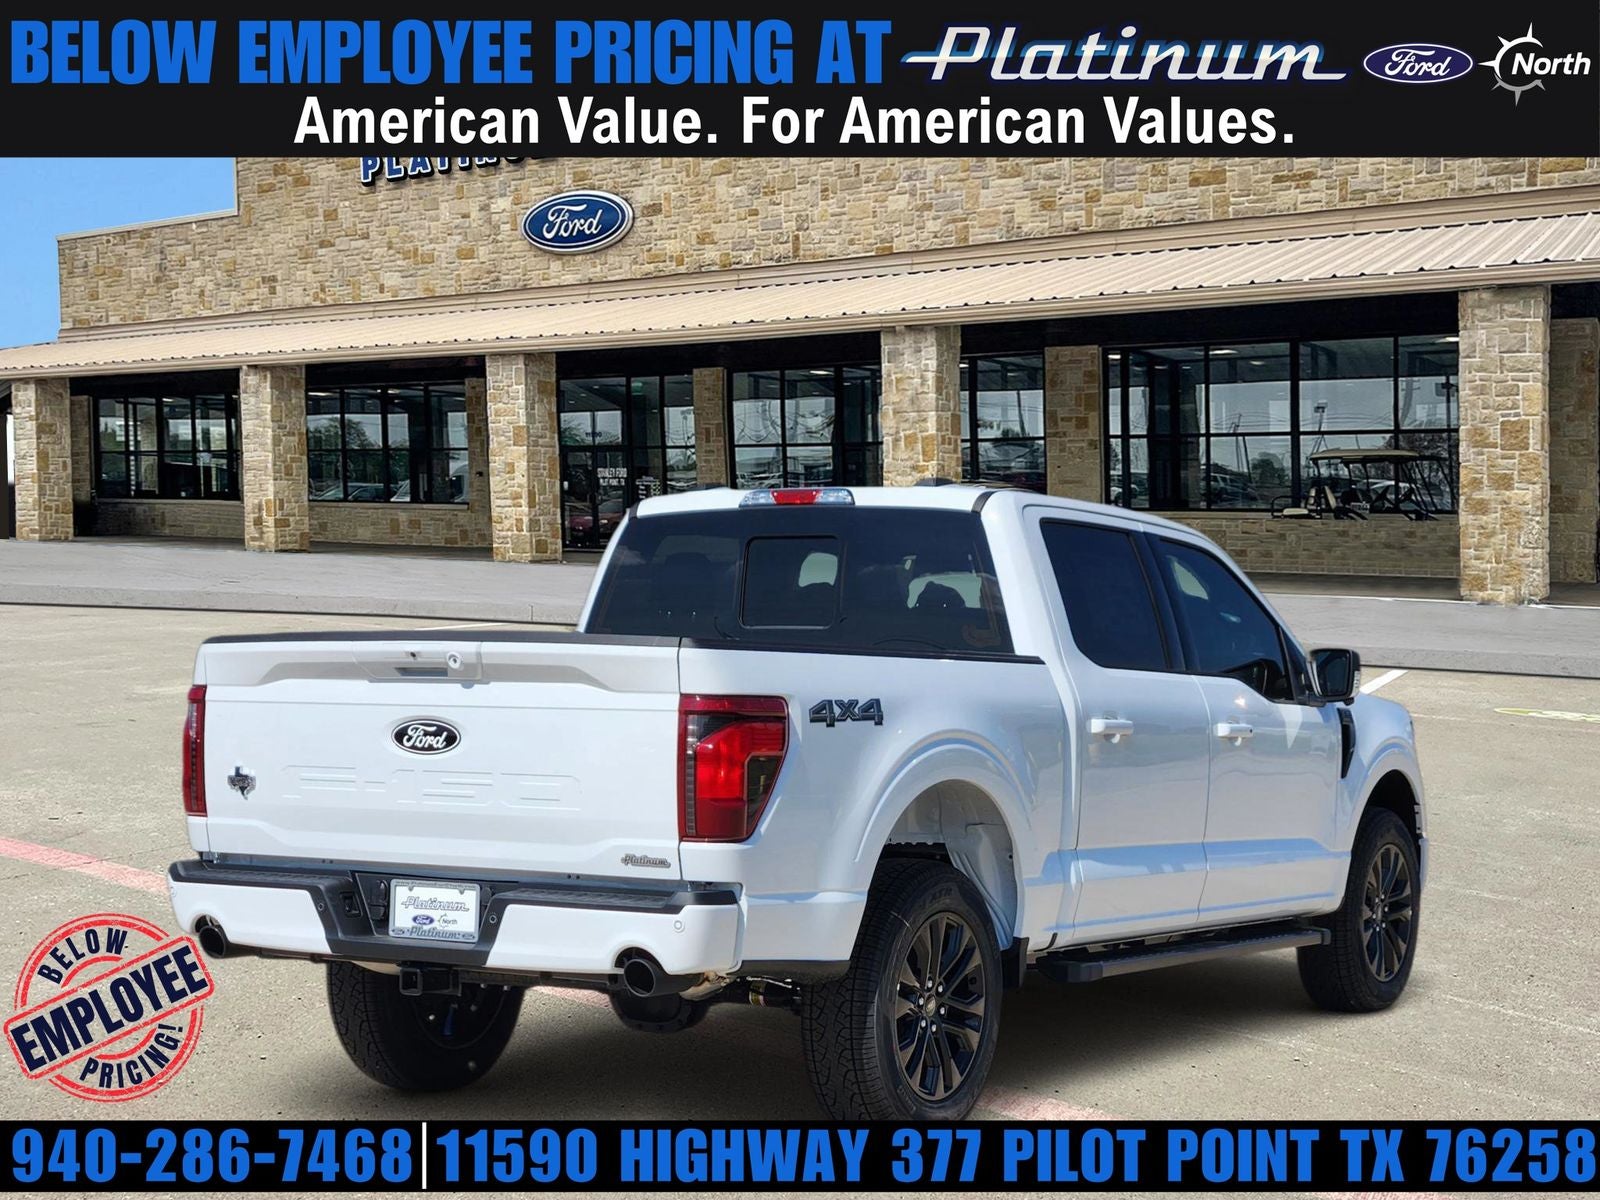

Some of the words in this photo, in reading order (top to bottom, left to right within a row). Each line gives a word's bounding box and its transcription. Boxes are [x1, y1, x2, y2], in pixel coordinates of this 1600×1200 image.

[542, 203, 604, 240] Ford
[402, 724, 448, 749] Ford
[401, 895, 470, 912] Platinum
